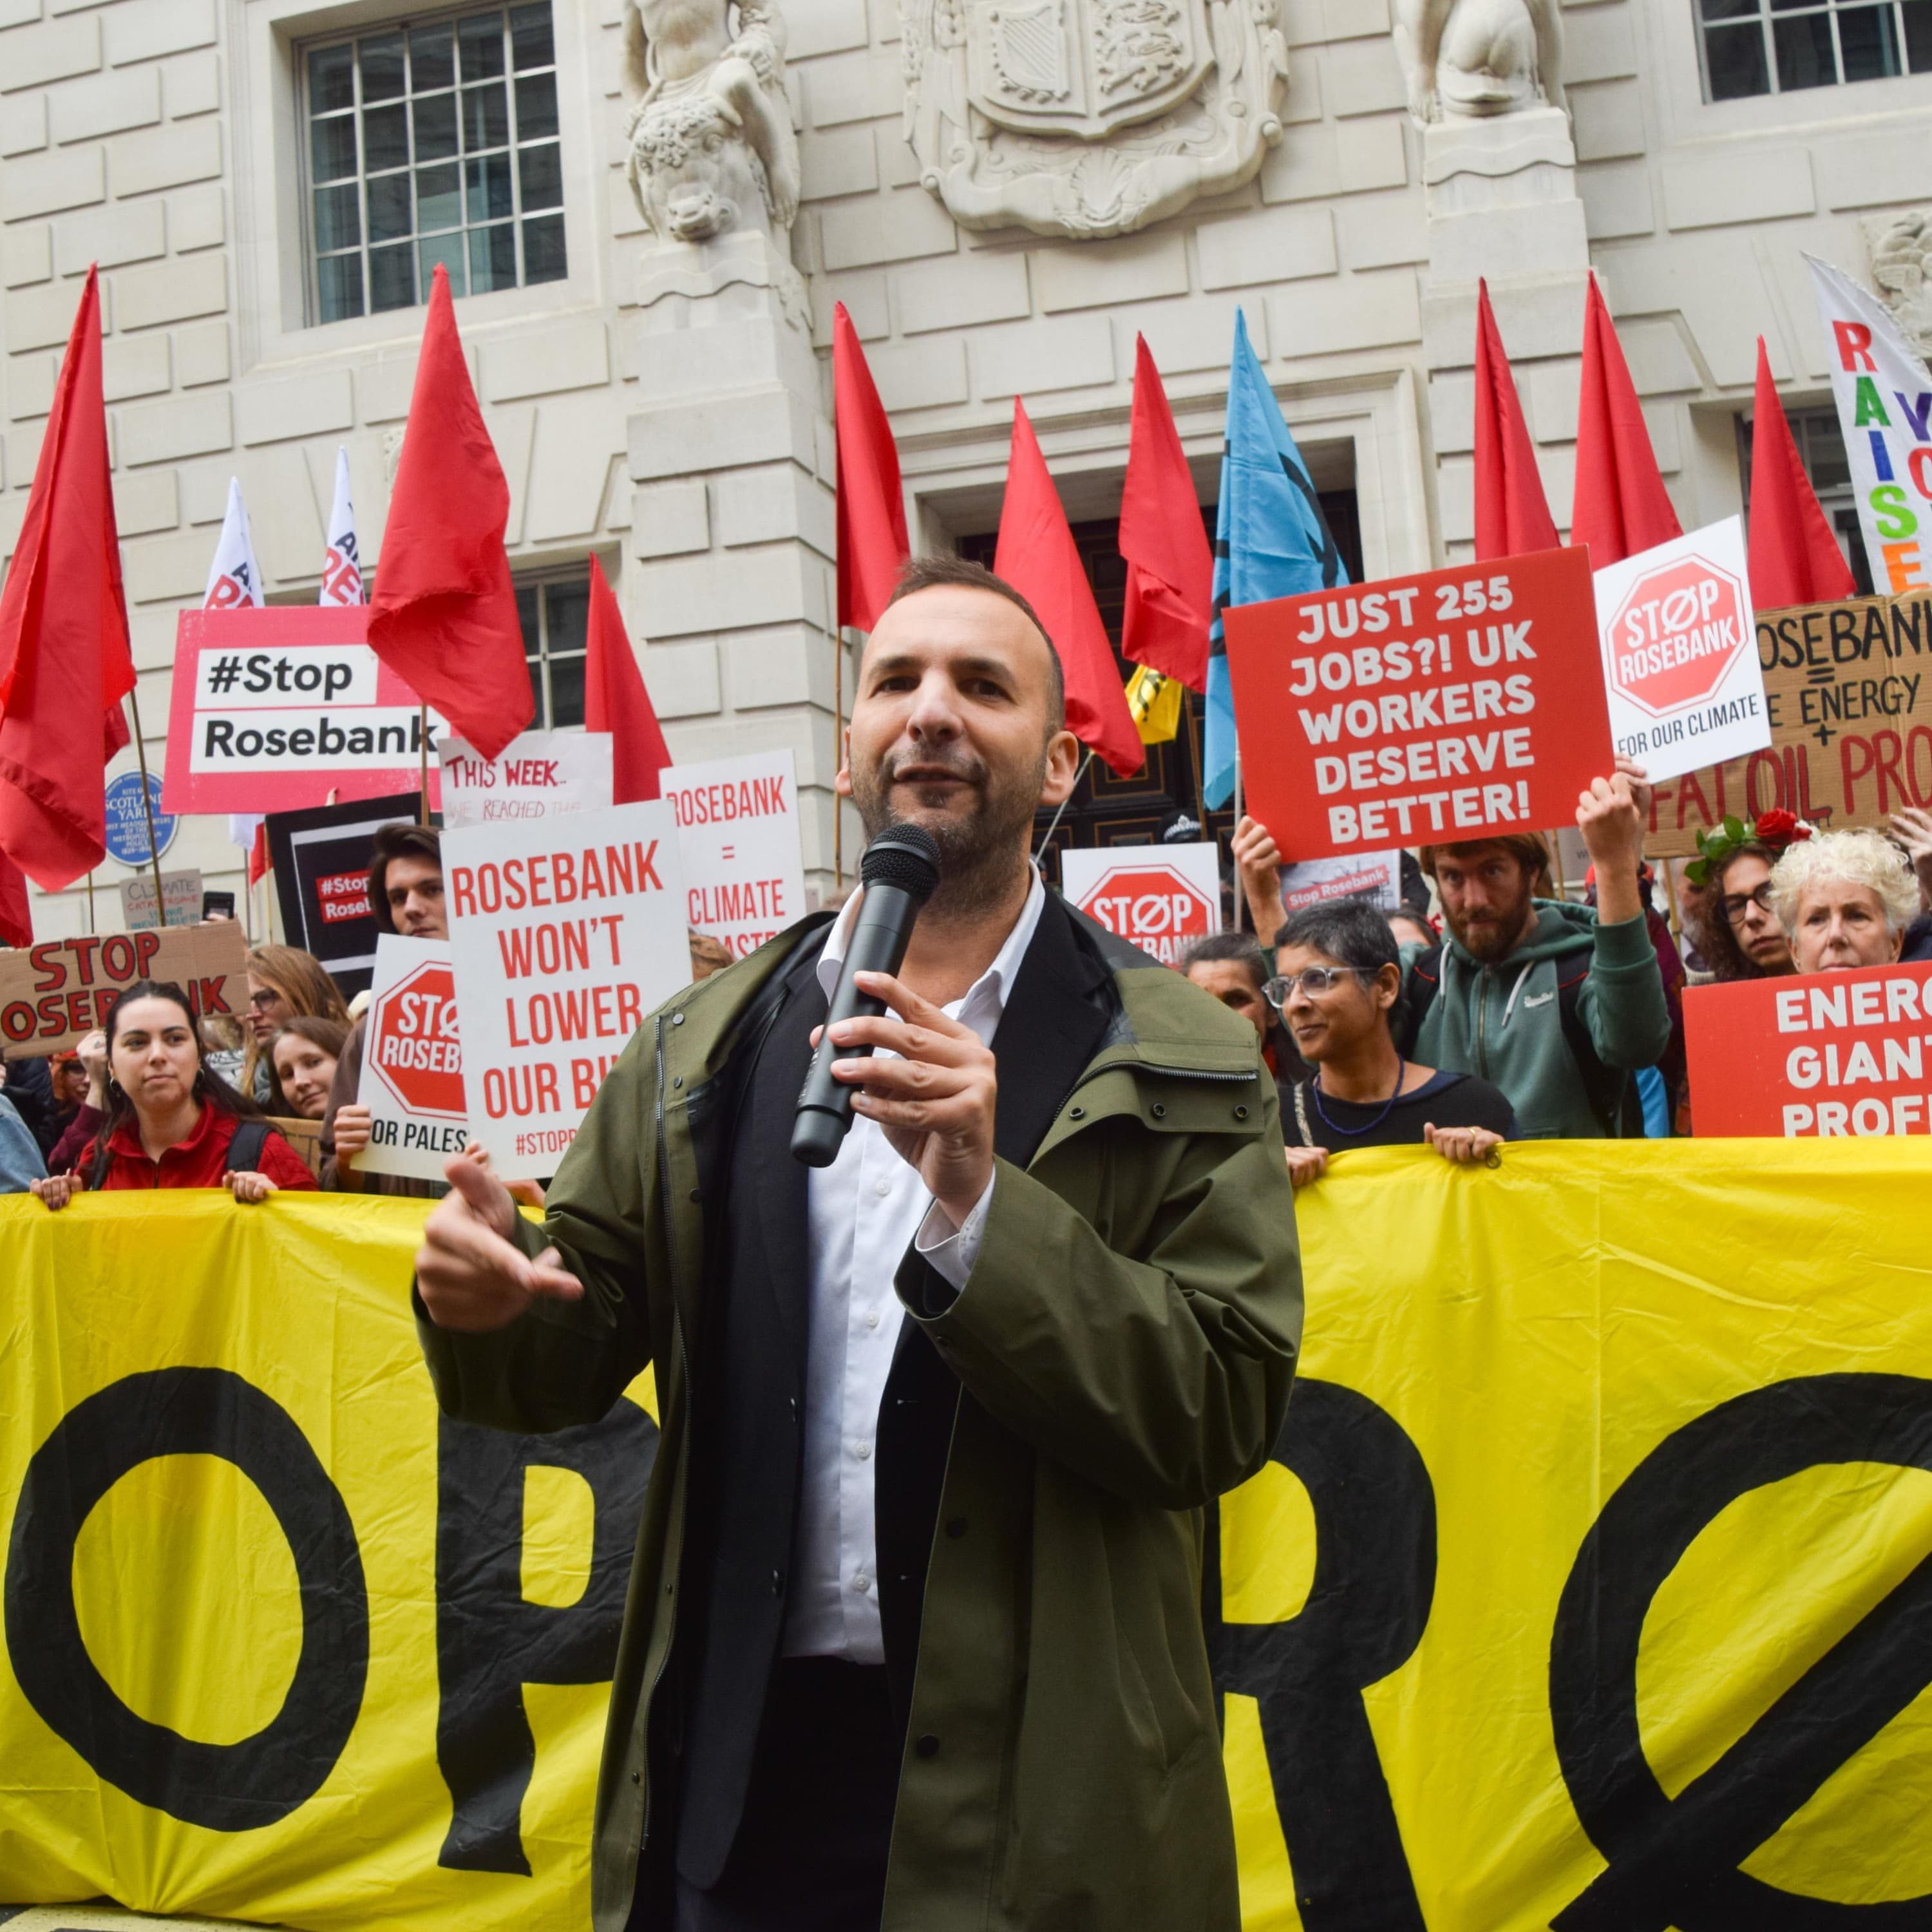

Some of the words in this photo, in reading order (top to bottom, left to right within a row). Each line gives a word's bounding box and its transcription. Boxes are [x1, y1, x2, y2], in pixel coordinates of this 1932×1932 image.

[1296, 587, 1419, 644] JUST
[1435, 576, 1513, 621] 255
[207, 654, 352, 701] #Stop
[1289, 634, 1452, 696] JOBS?!
[1467, 620, 1537, 667] UK
[1619, 616, 1737, 685] ROSEBANK
[1298, 674, 1535, 745] WORKERS
[1618, 732, 1648, 757] FOR
[1652, 719, 1684, 748] OUR
[1688, 693, 1759, 736] CLIMATE
[1800, 674, 1921, 724] ENERGY
[205, 715, 439, 758] Rosebank
[1314, 727, 1534, 795] DESERVE
[445, 755, 497, 788] THIS
[483, 799, 545, 820] REACHED
[1328, 781, 1530, 844] BETTER!
[451, 840, 664, 917] ROSEBANK
[688, 879, 785, 925] CLIMATE
[1289, 890, 1320, 907] Stop
[1321, 869, 1385, 897] Rosebank
[30, 931, 160, 992] STOP
[506, 983, 643, 1048] LOWER
[484, 1063, 561, 1119] OUR
